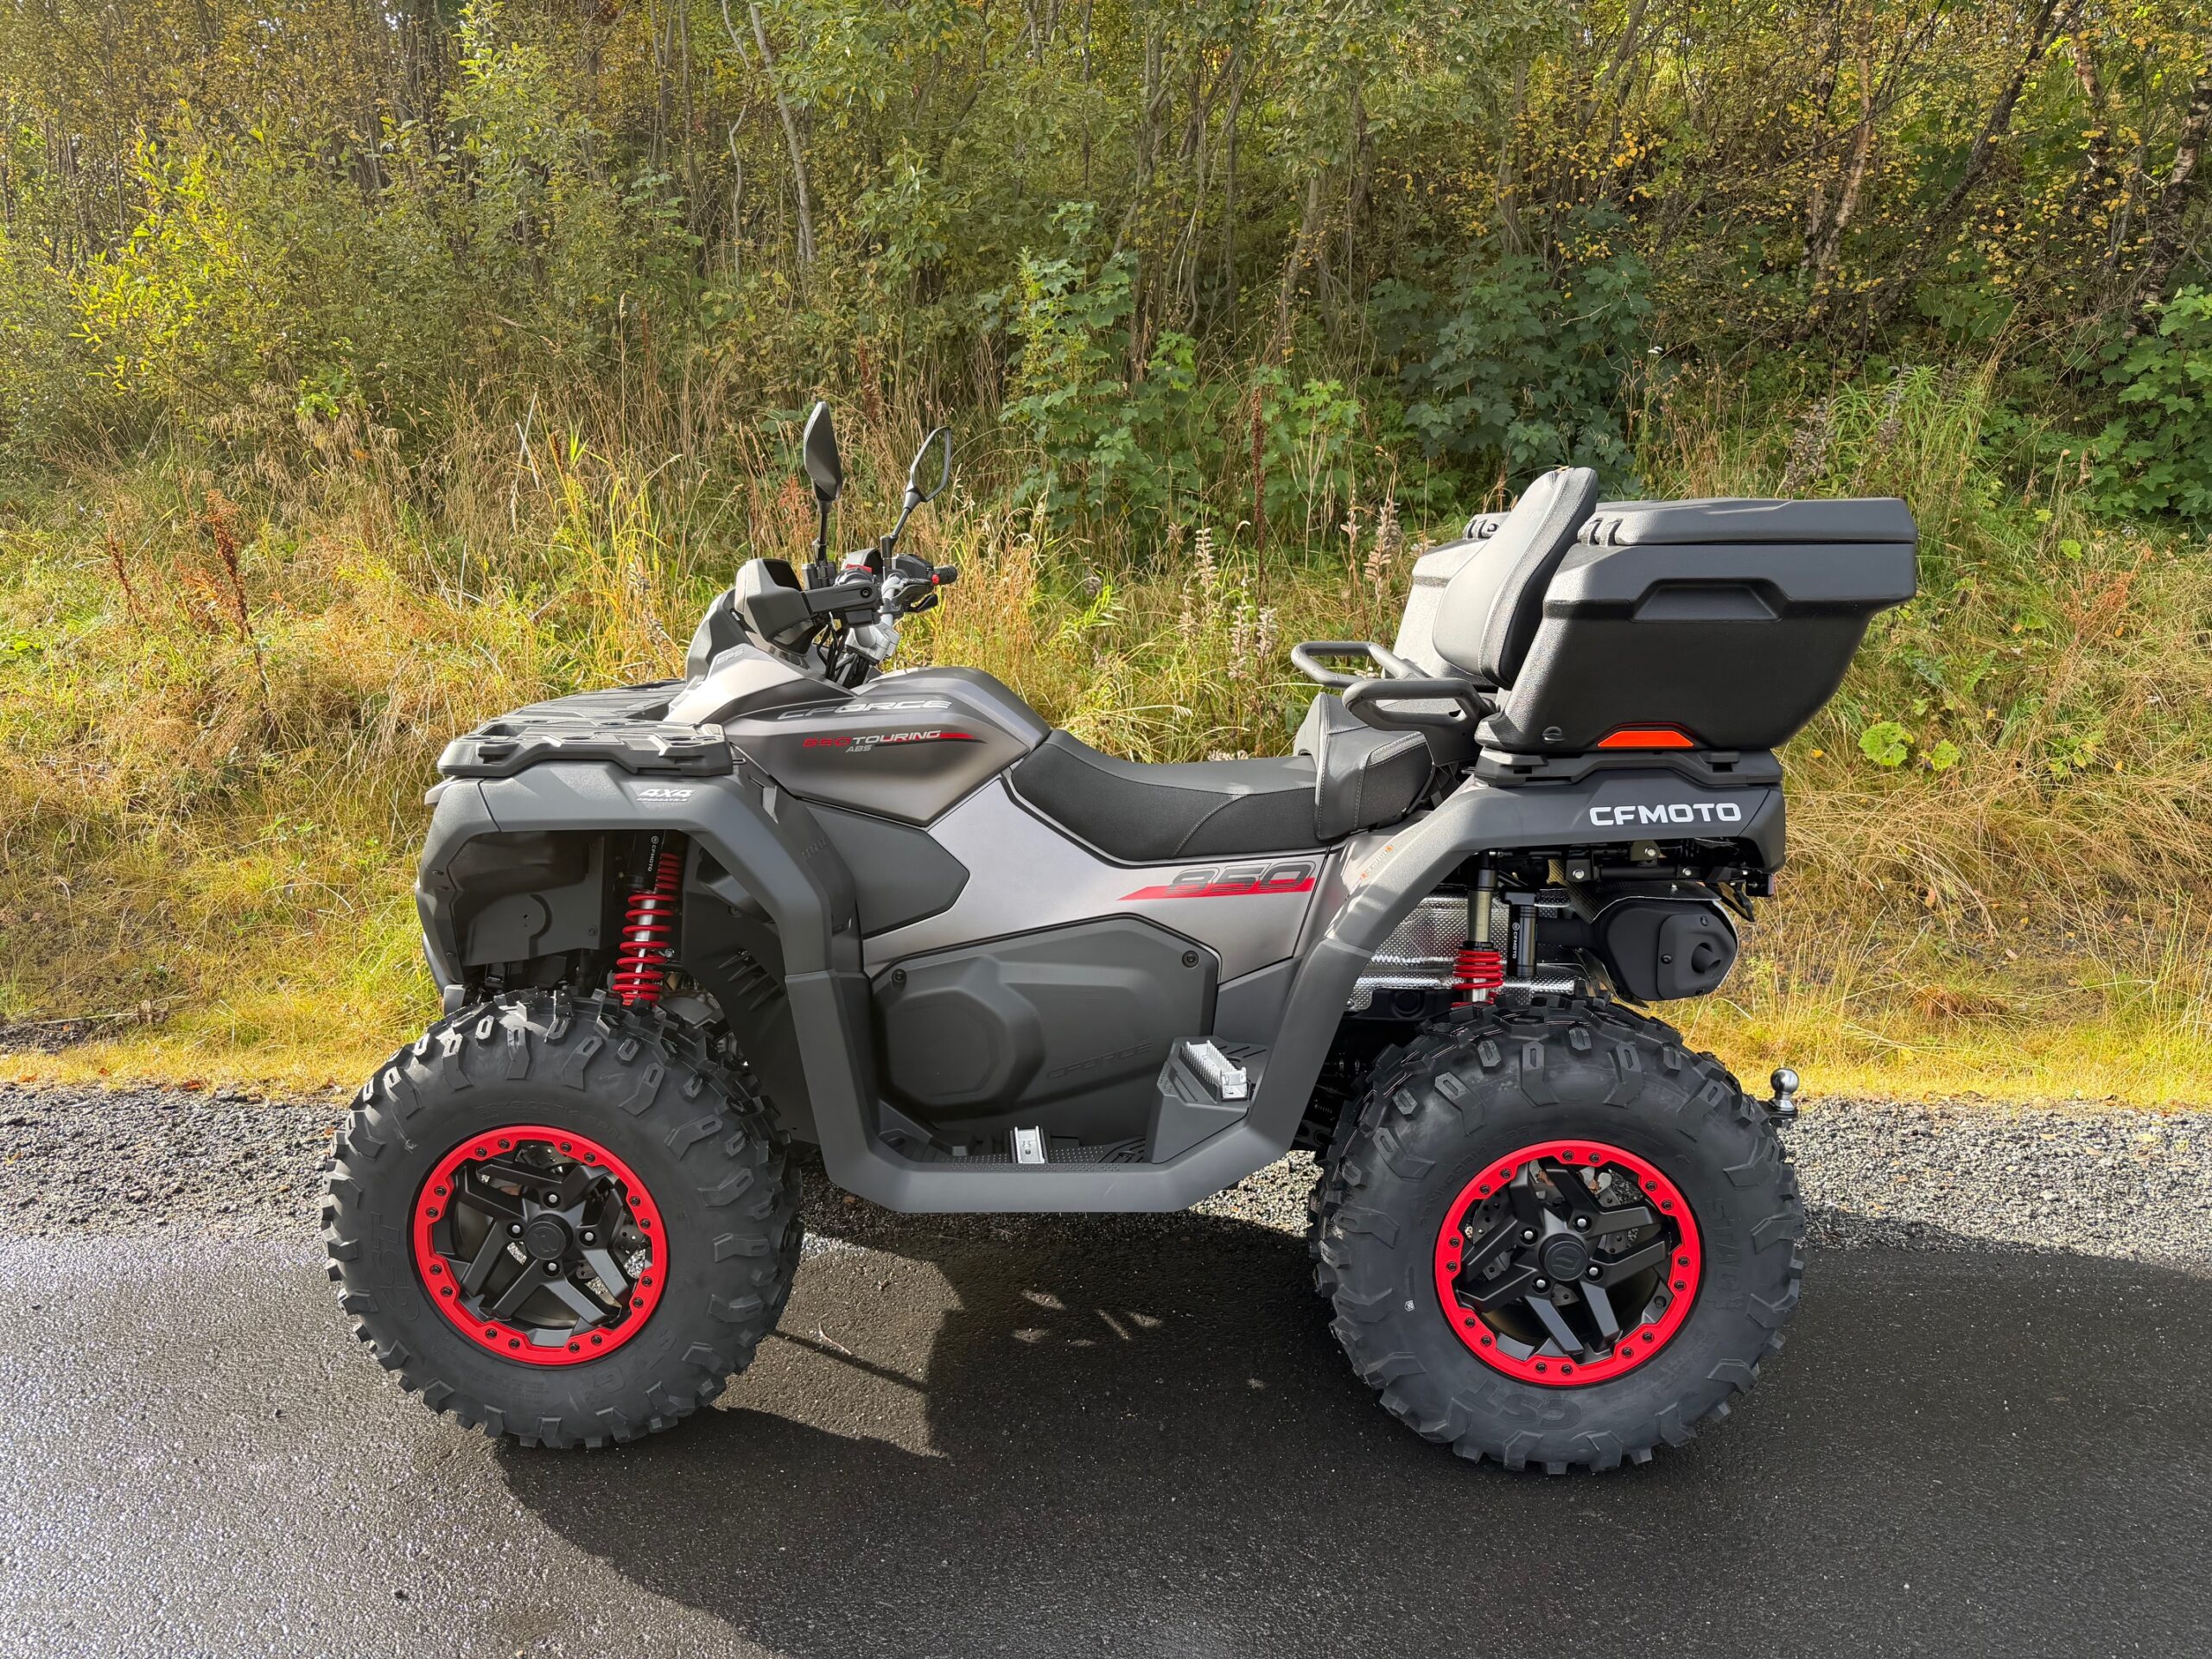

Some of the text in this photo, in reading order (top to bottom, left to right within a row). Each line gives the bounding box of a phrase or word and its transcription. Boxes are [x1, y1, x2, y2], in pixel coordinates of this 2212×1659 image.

[716, 649, 745, 664] EPS
[777, 699, 952, 721] CFORCE
[852, 730, 942, 744] TOURING
[845, 745, 873, 753] ABS
[1590, 803, 1741, 826] CFMOTO
[647, 843, 657, 873] CFMOTO
[1165, 861, 1316, 894] 850
[1459, 1381, 1582, 1429] CST
